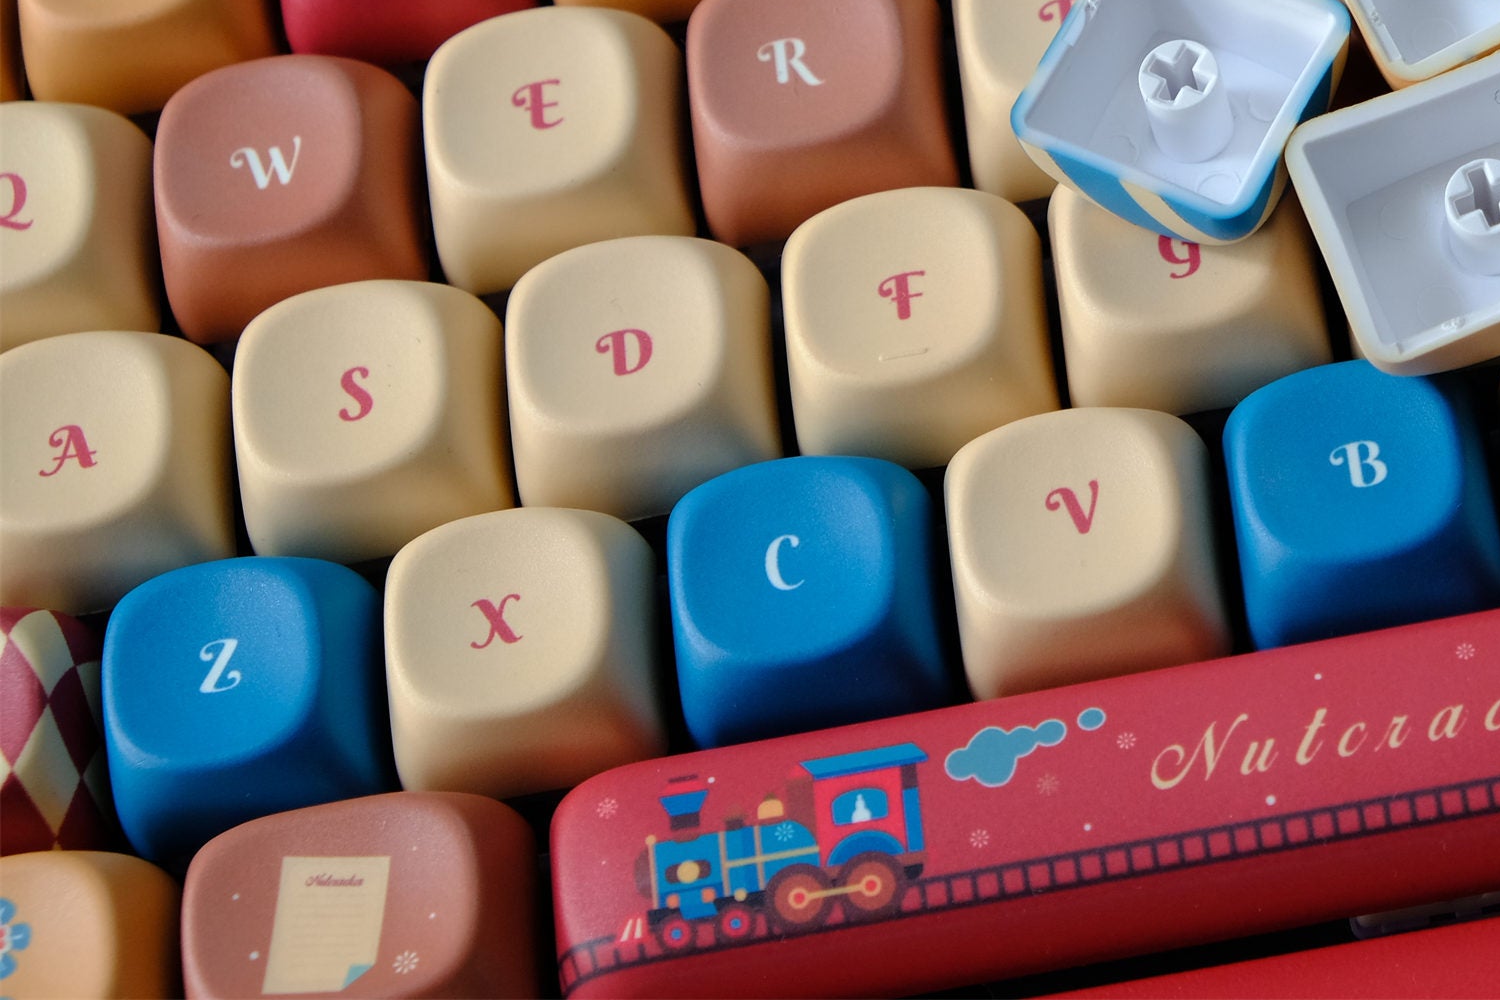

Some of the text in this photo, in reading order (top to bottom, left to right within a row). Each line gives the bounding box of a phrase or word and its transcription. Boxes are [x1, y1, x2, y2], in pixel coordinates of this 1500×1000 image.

[757, 38, 823, 86] R
[512, 79, 563, 130] E
[230, 136, 301, 189] W
[878, 270, 925, 320] F
[595, 329, 653, 376] D
[339, 366, 373, 422] S
[39, 425, 97, 477] A
[1330, 441, 1387, 487] B
[1045, 480, 1099, 534] V
[765, 535, 804, 590] C
[471, 594, 523, 649] X
[200, 639, 241, 693] Z
